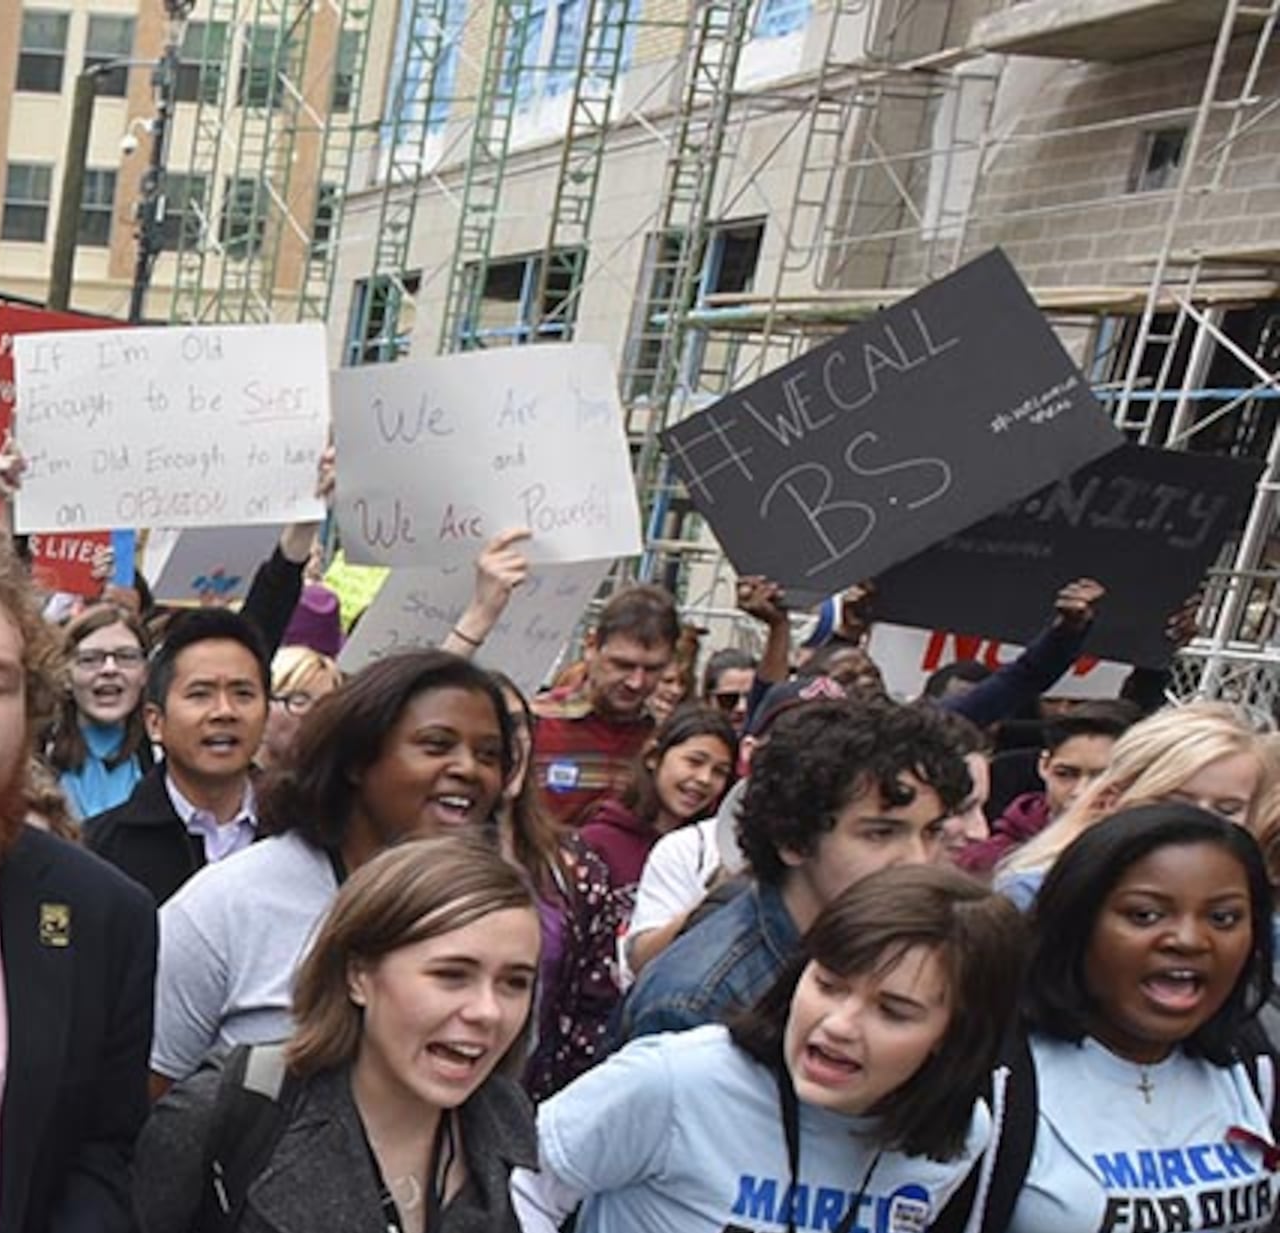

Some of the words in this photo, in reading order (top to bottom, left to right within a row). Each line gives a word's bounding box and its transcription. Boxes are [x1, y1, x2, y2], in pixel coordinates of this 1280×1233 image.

[371, 390, 457, 445] We
[354, 496, 418, 549] We
[1092, 1143, 1257, 1190] MARCH
[1196, 1178, 1272, 1230] OUR
